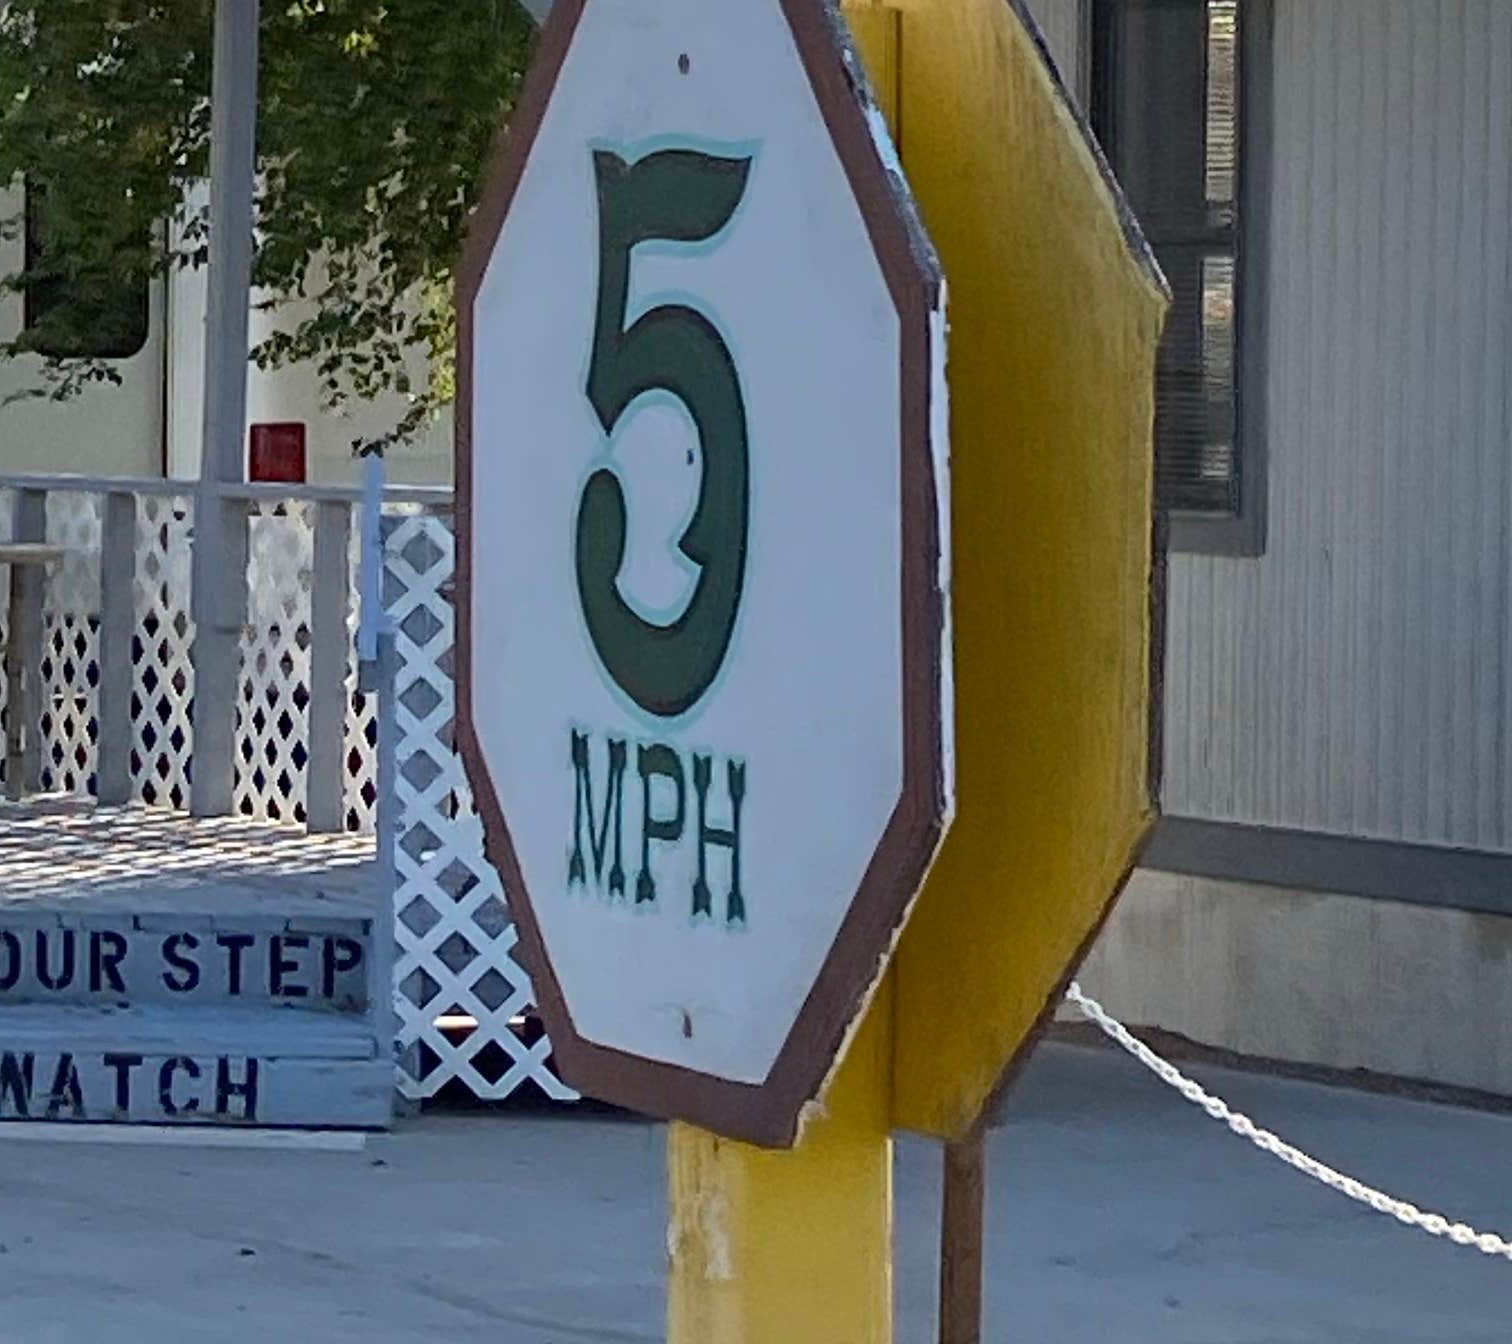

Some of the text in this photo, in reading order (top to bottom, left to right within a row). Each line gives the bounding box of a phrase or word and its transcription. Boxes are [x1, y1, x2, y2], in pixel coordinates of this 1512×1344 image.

[575, 141, 758, 718] 5
[566, 727, 750, 925] MPH
[160, 932, 364, 998] STEP
